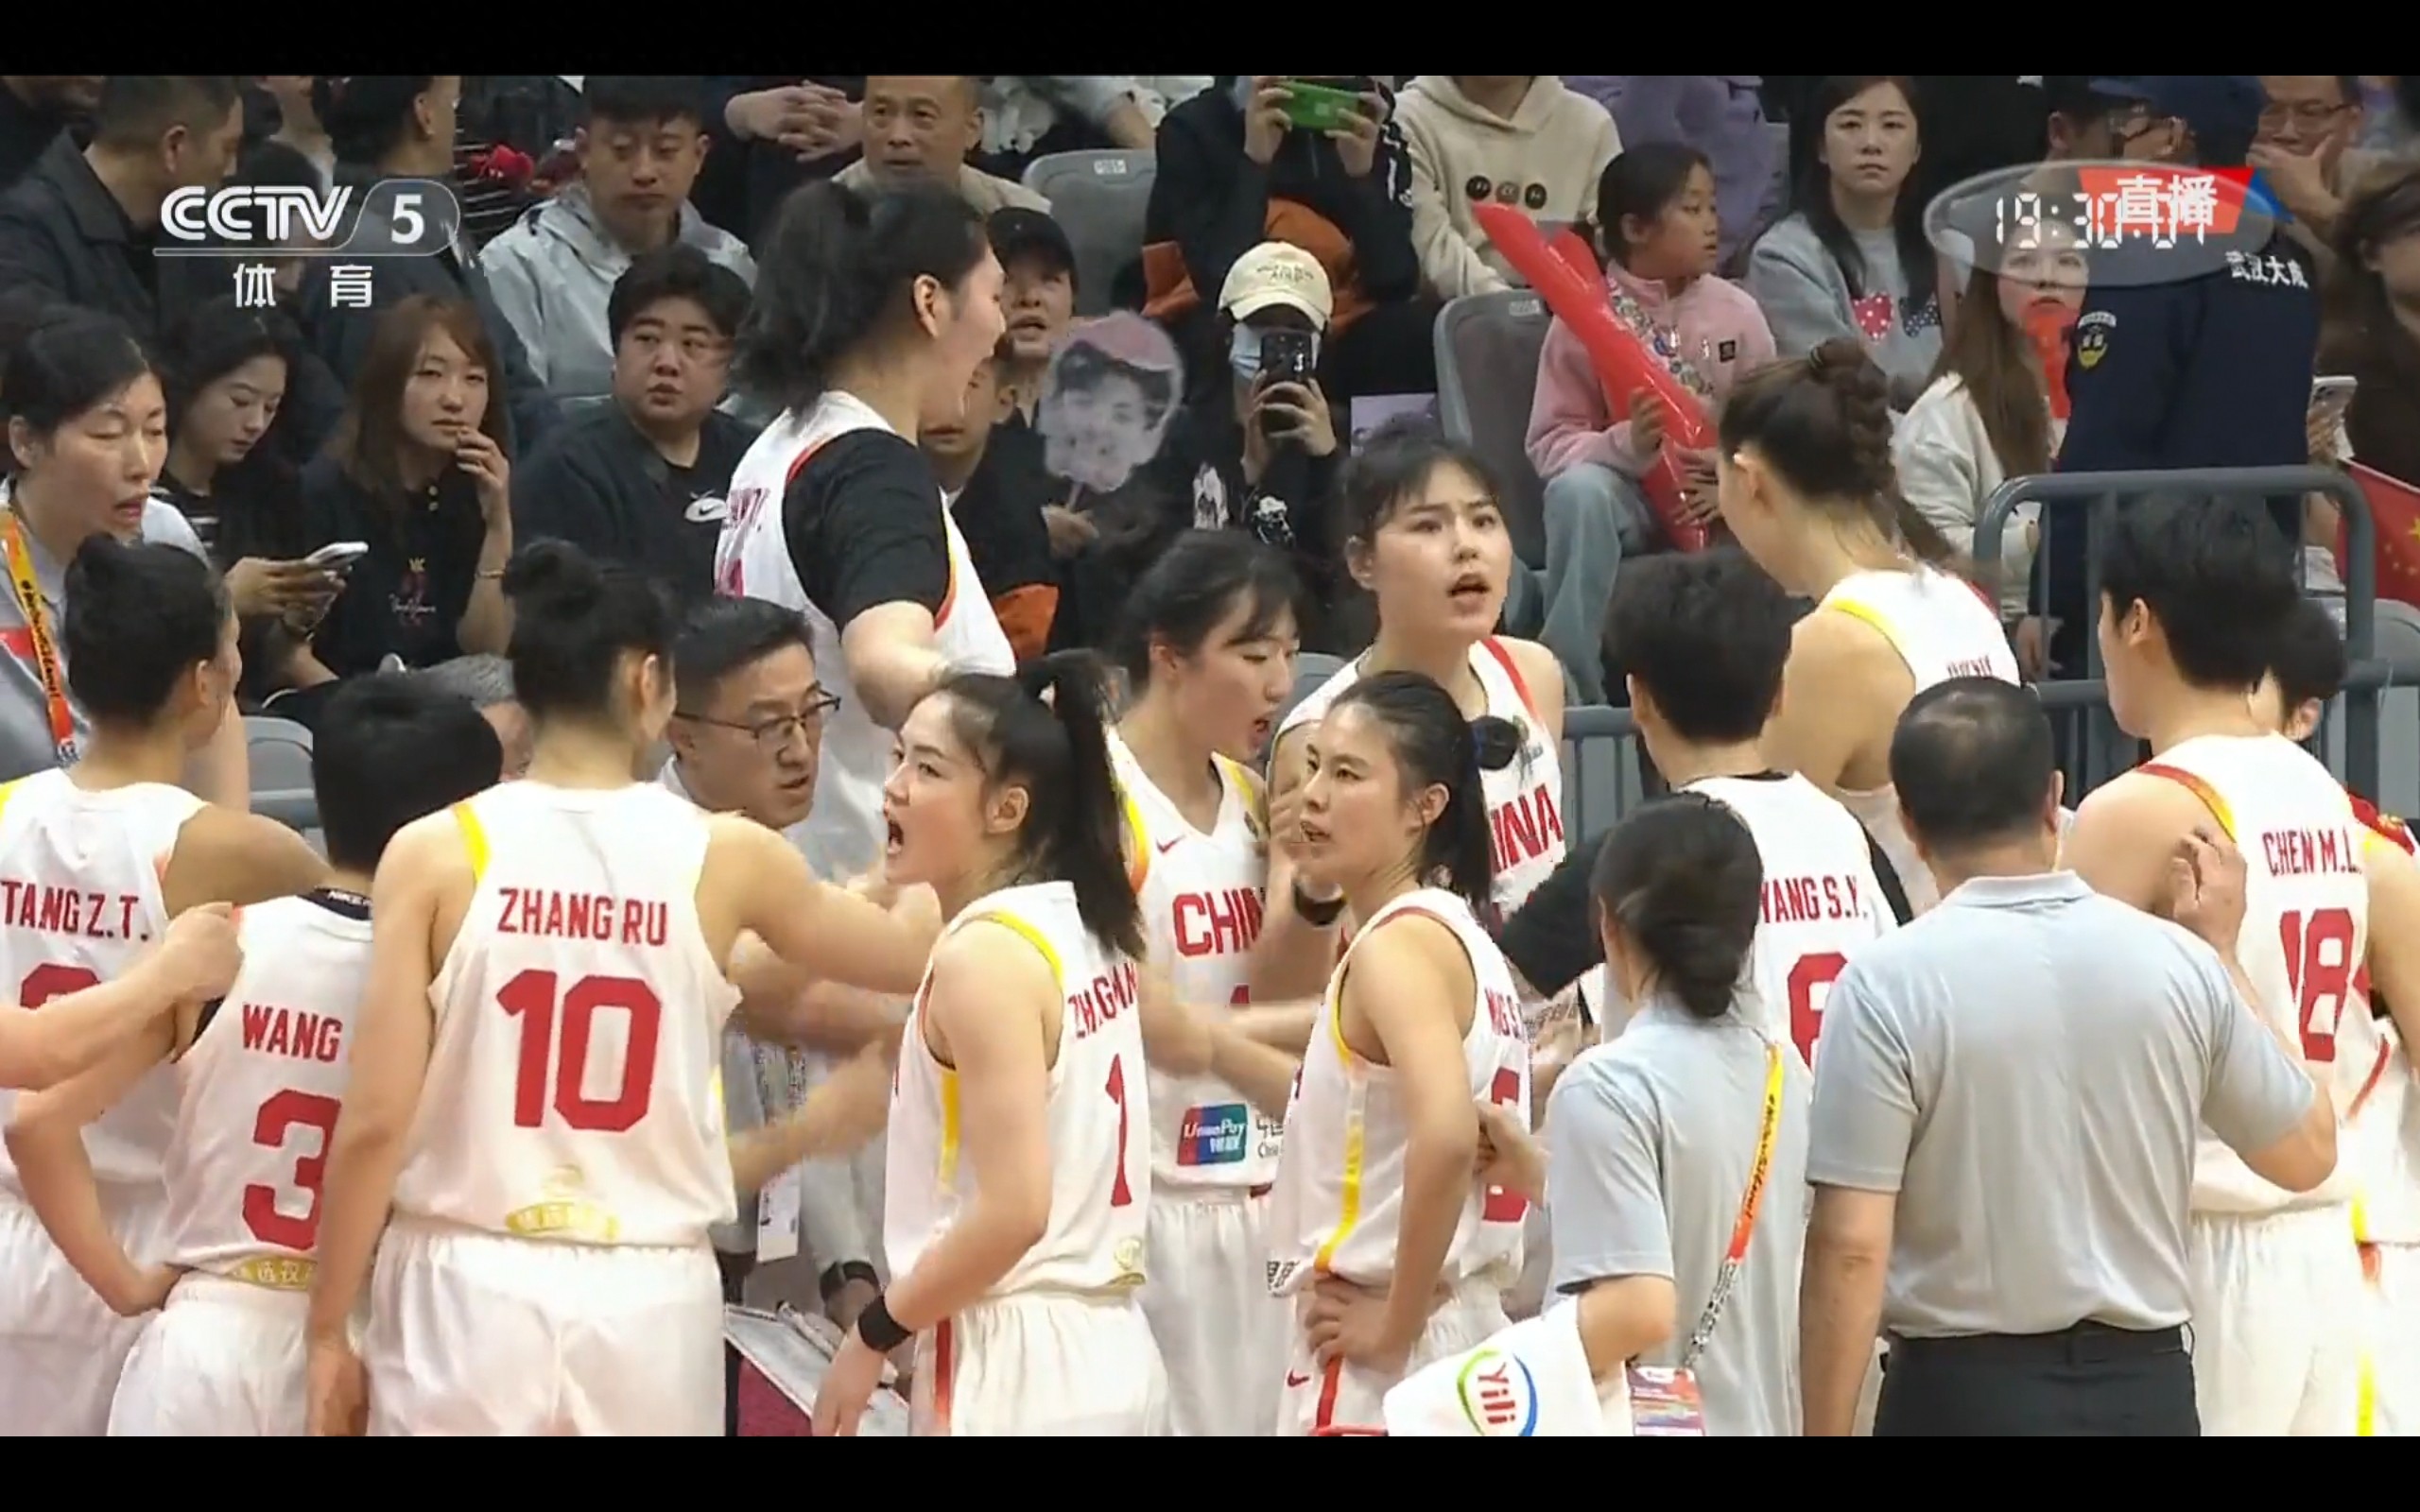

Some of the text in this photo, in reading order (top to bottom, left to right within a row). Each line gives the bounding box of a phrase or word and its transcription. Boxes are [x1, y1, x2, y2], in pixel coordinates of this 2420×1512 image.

[2262, 826, 2315, 877] CHEN
[0, 880, 149, 942] TANG Z.T.
[497, 887, 667, 947] ZHANG RU
[2279, 907, 2354, 1063] 18
[242, 1004, 343, 1063] WANG
[496, 969, 664, 1133] 10
[242, 1088, 342, 1251] 3
[1477, 1362, 1516, 1425] Yili
